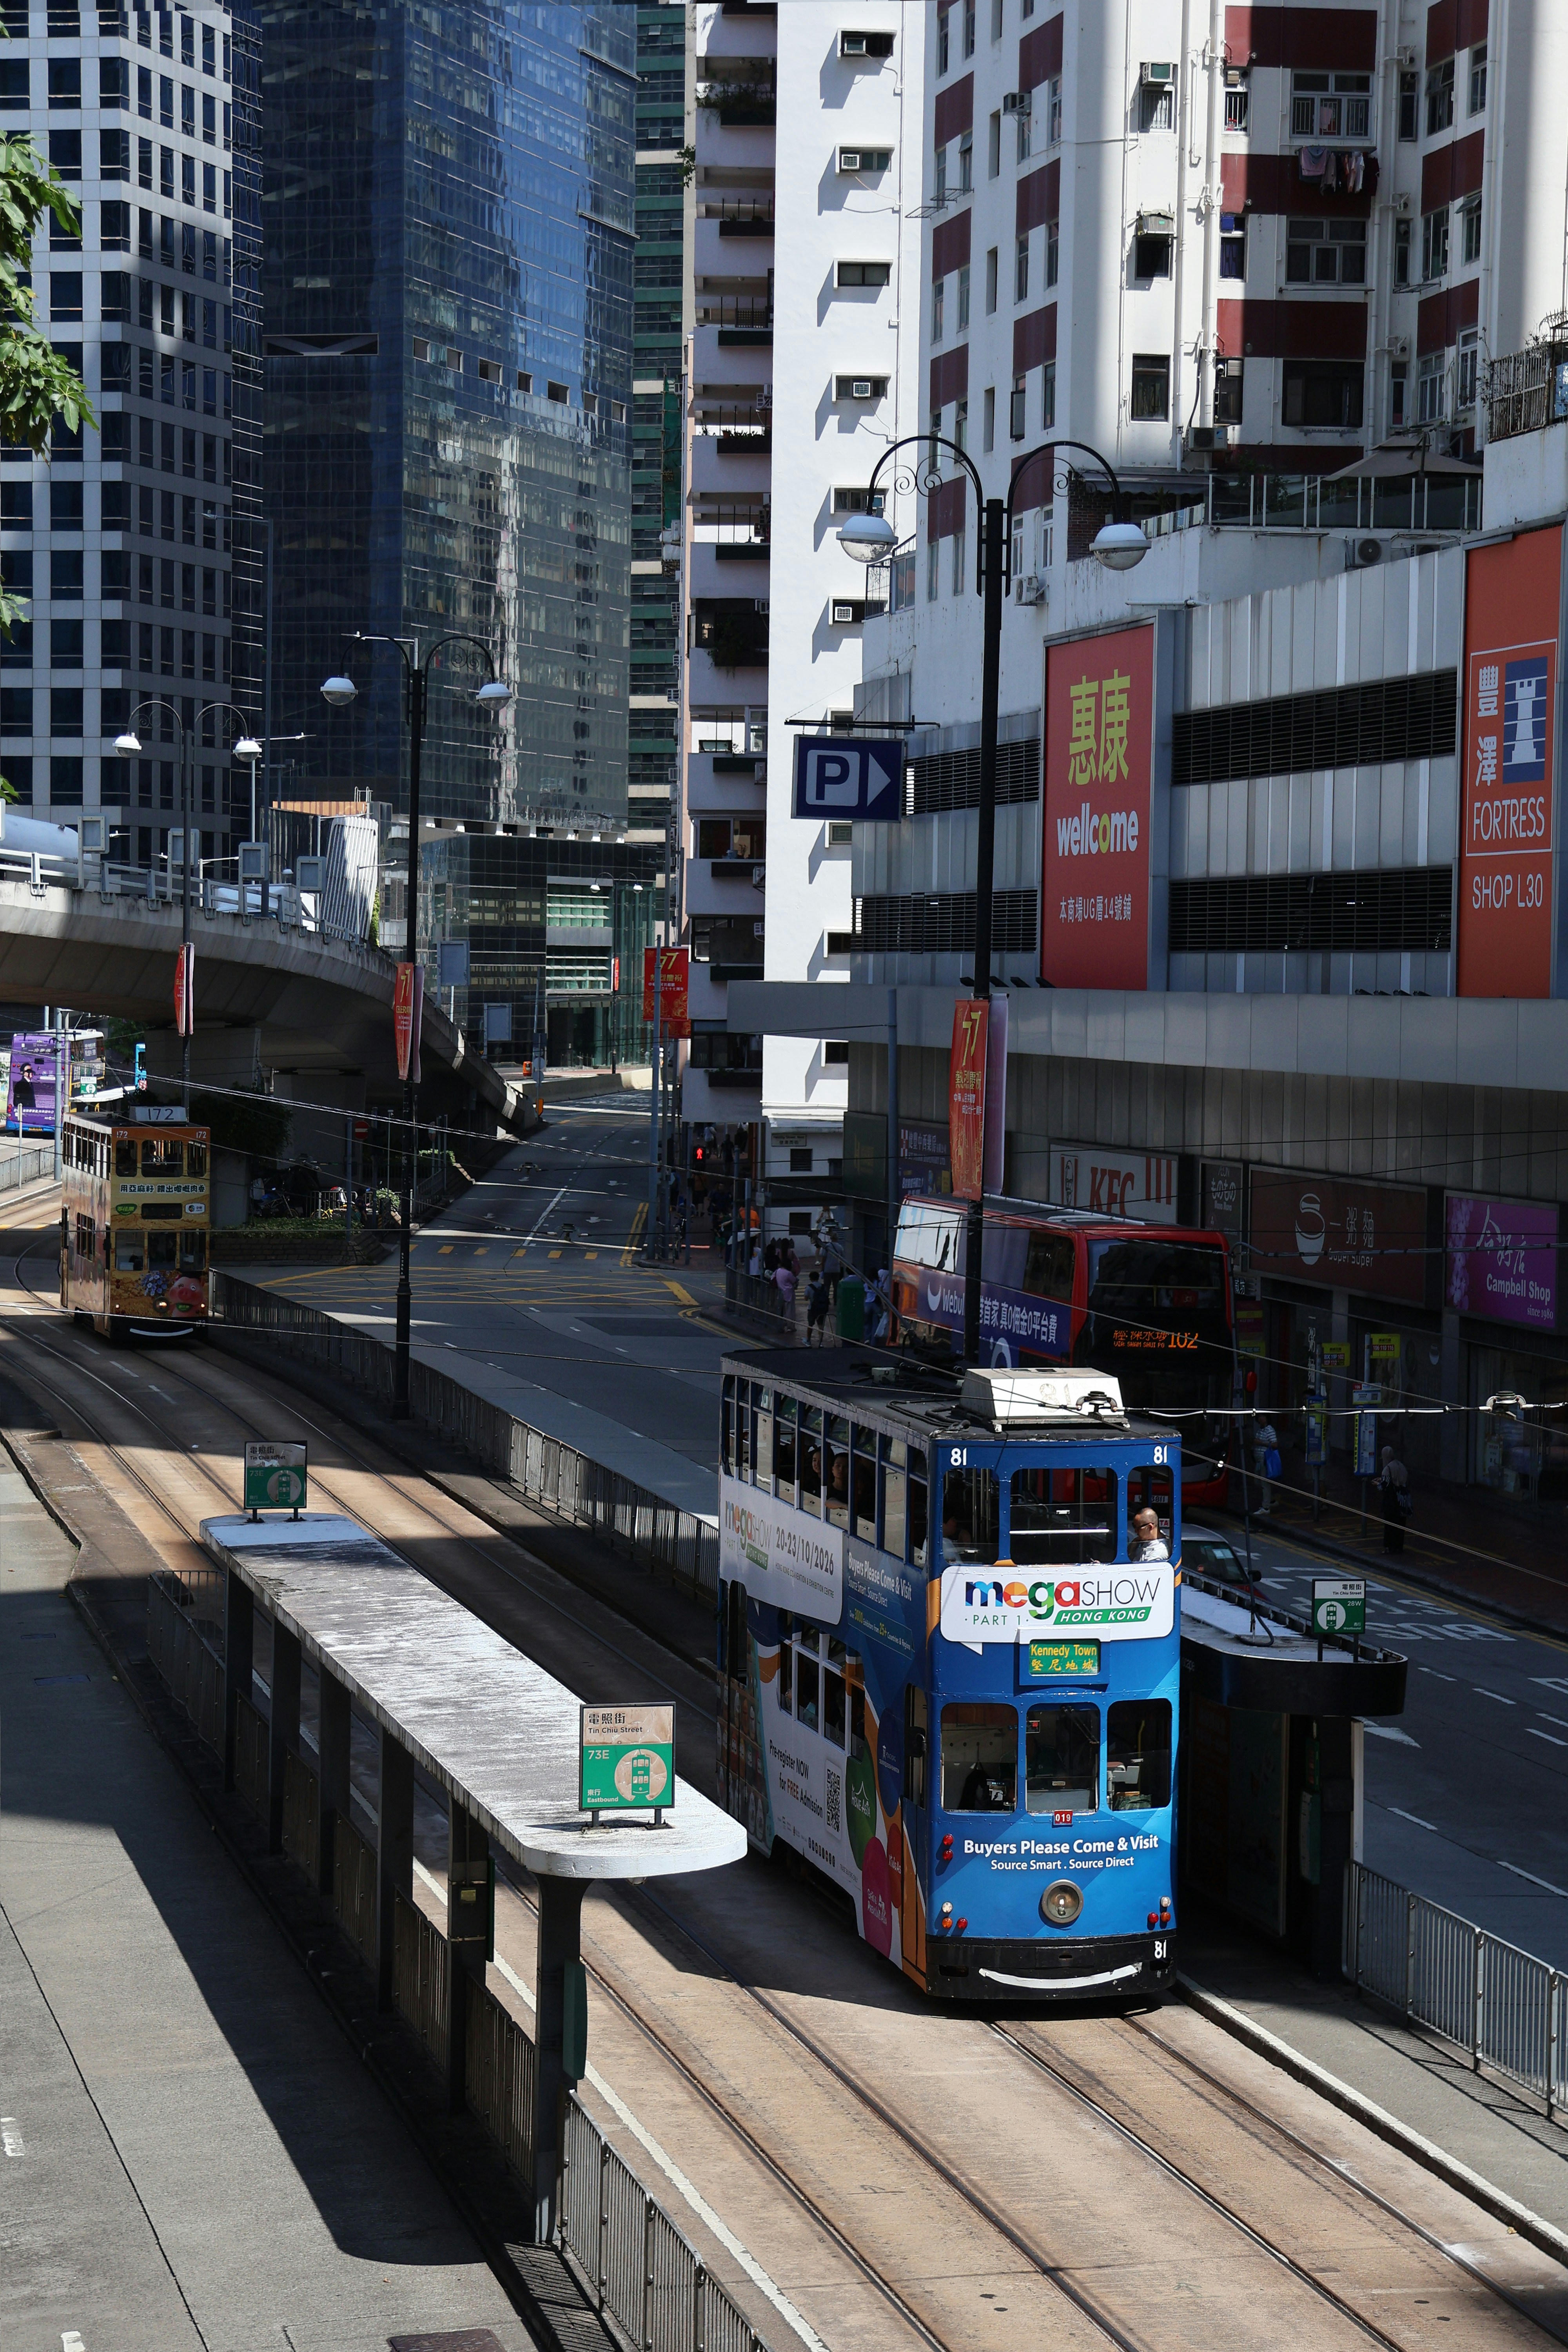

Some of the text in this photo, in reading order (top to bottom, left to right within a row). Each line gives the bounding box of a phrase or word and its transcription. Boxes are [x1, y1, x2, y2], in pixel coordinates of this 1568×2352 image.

[1069, 669, 1130, 785] 惠康
[1476, 665, 1499, 786] 豐澤
[816, 755, 850, 800] P
[1473, 796, 1545, 840] FORTRESS
[1057, 803, 1138, 857] wellcome
[1473, 873, 1543, 909] SHOP L30
[660, 953, 679, 969] 77
[400, 969, 410, 1002] 77
[962, 1012, 980, 1066] 77
[148, 1109, 174, 1120] 172
[1089, 1167, 1134, 1216] KFC
[1211, 1178, 1236, 1202] ものもの
[1486, 1273, 1551, 1305] Campbell Shop
[1527, 1305, 1553, 1320] since 1980
[1168, 1332, 1198, 1348] 102
[950, 1447, 967, 1466] 81
[1153, 1445, 1167, 1464] 81
[777, 1526, 833, 1575] 20-23/10/2026
[849, 1552, 911, 1601] Buyers Please Come & Visit
[973, 1614, 1014, 1626] PART
[1060, 1608, 1146, 1623] HONG KONG
[1366, 1622, 1518, 1641] BUS
[1031, 1644, 1097, 1657] Kennedy Town
[1031, 1658, 1094, 1672] 堅尼地城
[589, 1713, 625, 1724] 電照街
[588, 1750, 609, 1760] 73E
[770, 1739, 809, 1779] Pre-register NOW
[787, 1779, 799, 1800] FREE
[800, 1788, 822, 1818] Admission
[1055, 1813, 1071, 1822] 019
[964, 1835, 1158, 1857] Buyers Please Come & Visit
[991, 1856, 1134, 1869] Source Smart Source Direct
[1154, 1940, 1167, 1959] 81
